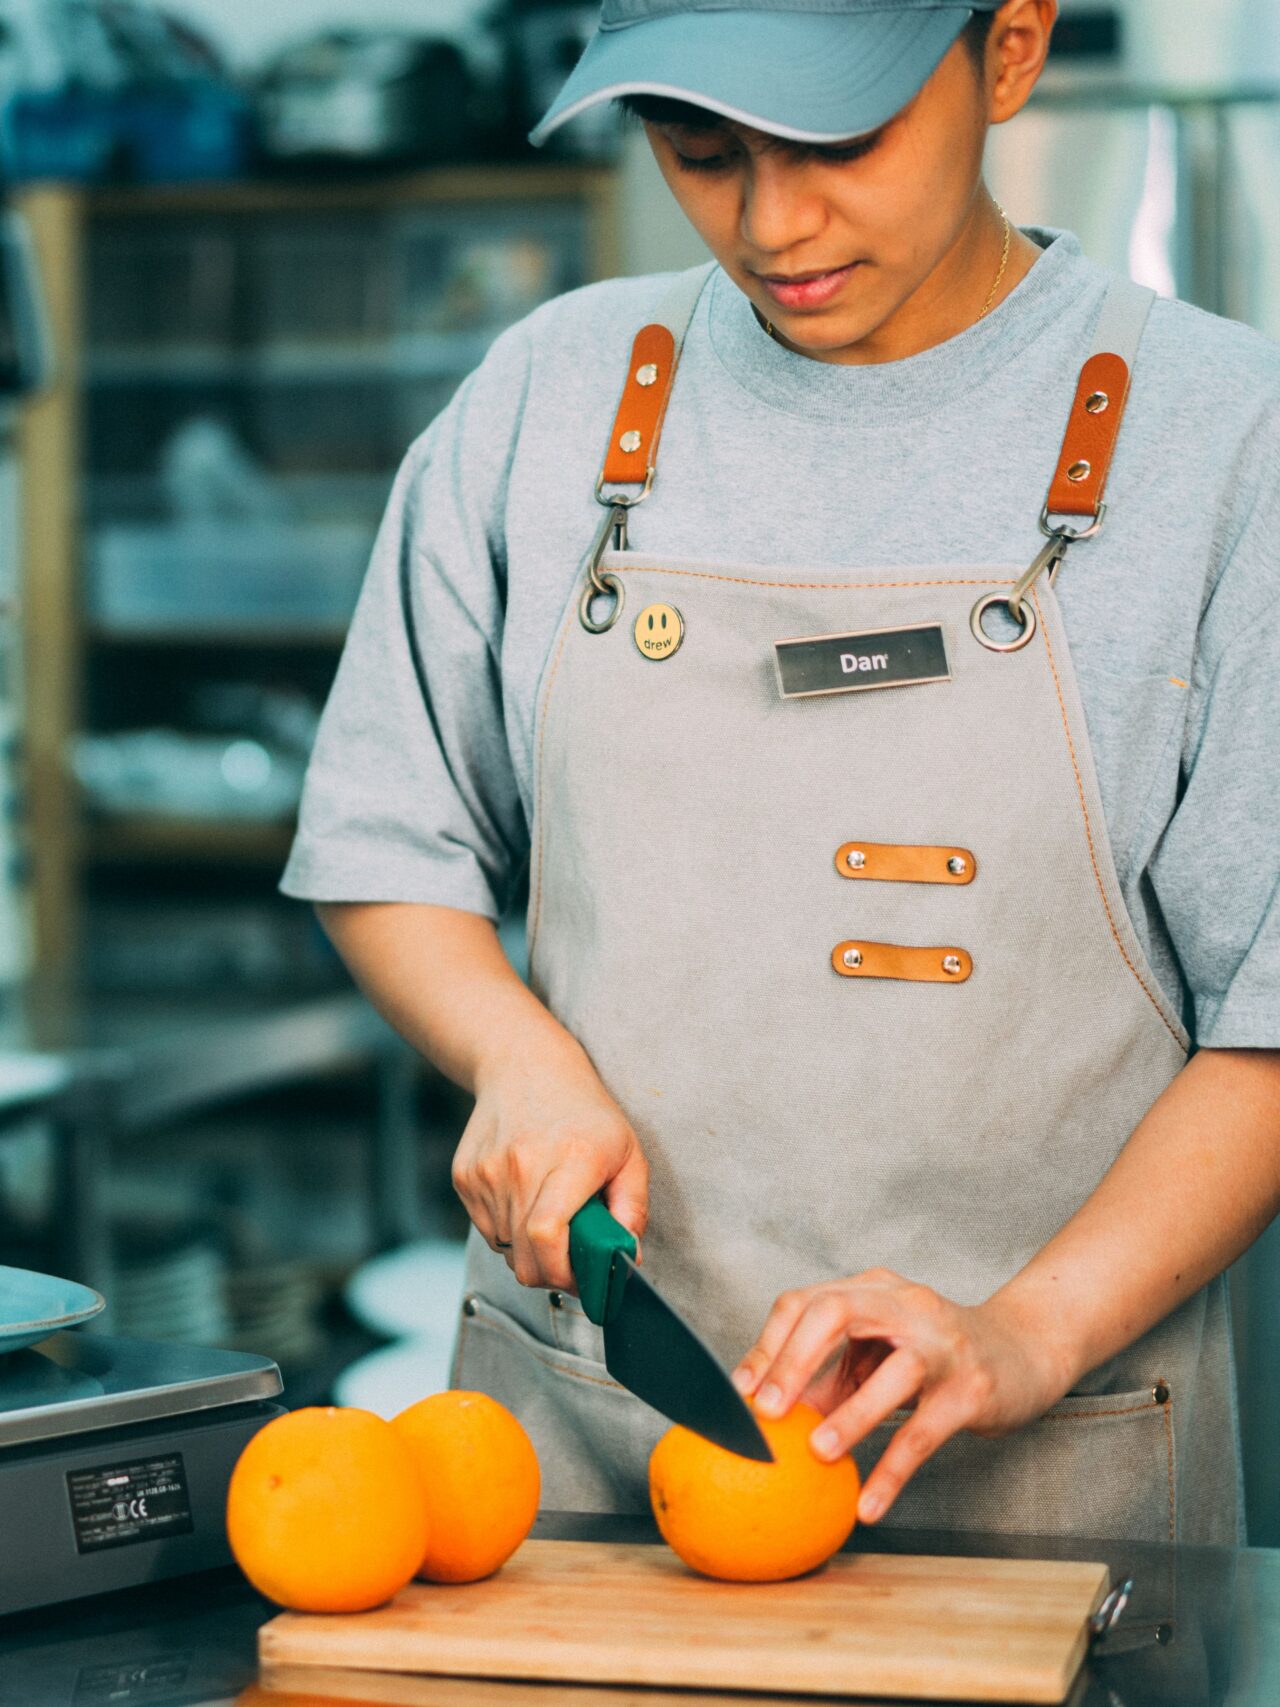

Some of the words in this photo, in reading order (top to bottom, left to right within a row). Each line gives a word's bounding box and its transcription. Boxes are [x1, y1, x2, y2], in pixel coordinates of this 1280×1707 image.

[644, 637, 672, 651] drew
[840, 653, 887, 673] Dan
[130, 1498, 148, 1519] CE
